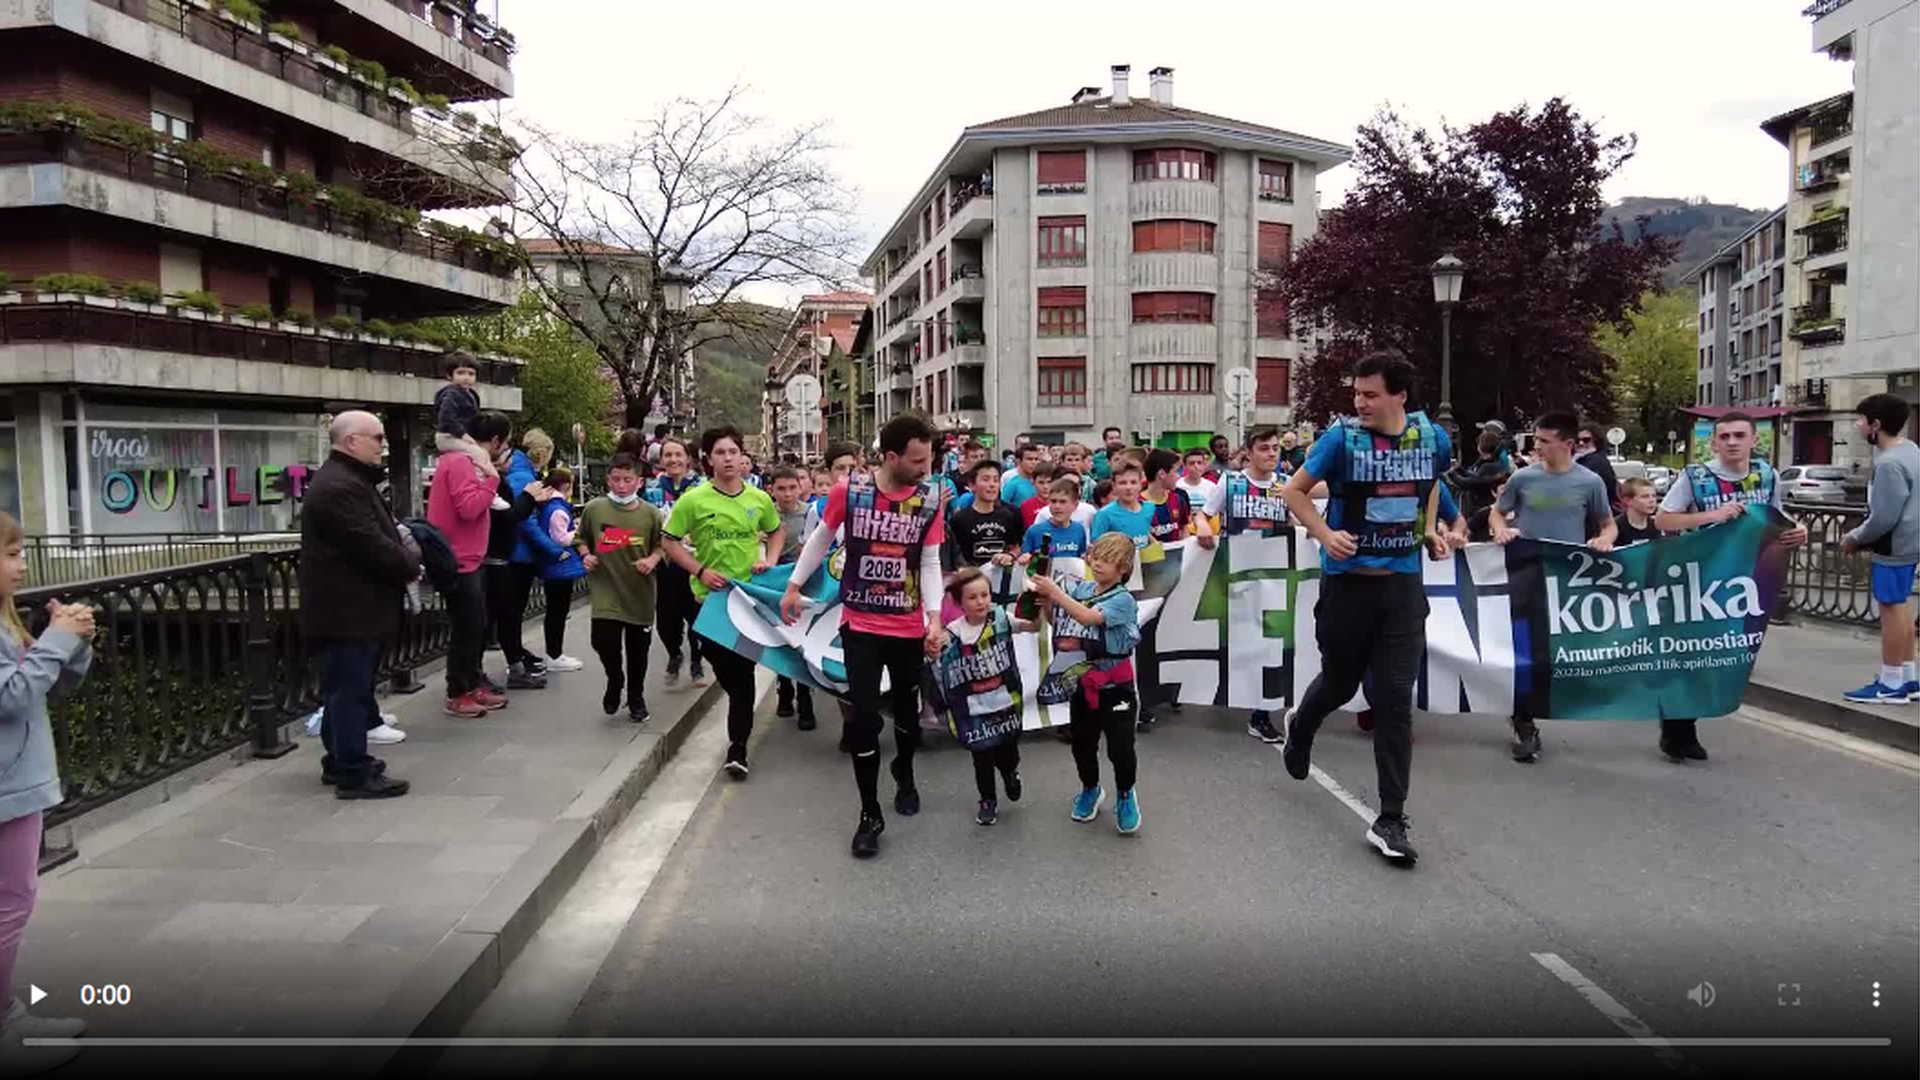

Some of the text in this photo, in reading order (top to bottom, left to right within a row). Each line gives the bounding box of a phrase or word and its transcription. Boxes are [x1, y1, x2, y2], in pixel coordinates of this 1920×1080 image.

[864, 560, 902, 579] 2082
[1545, 561, 1765, 635] korrika
[1555, 629, 1763, 664] Amurriotik Donostiara
